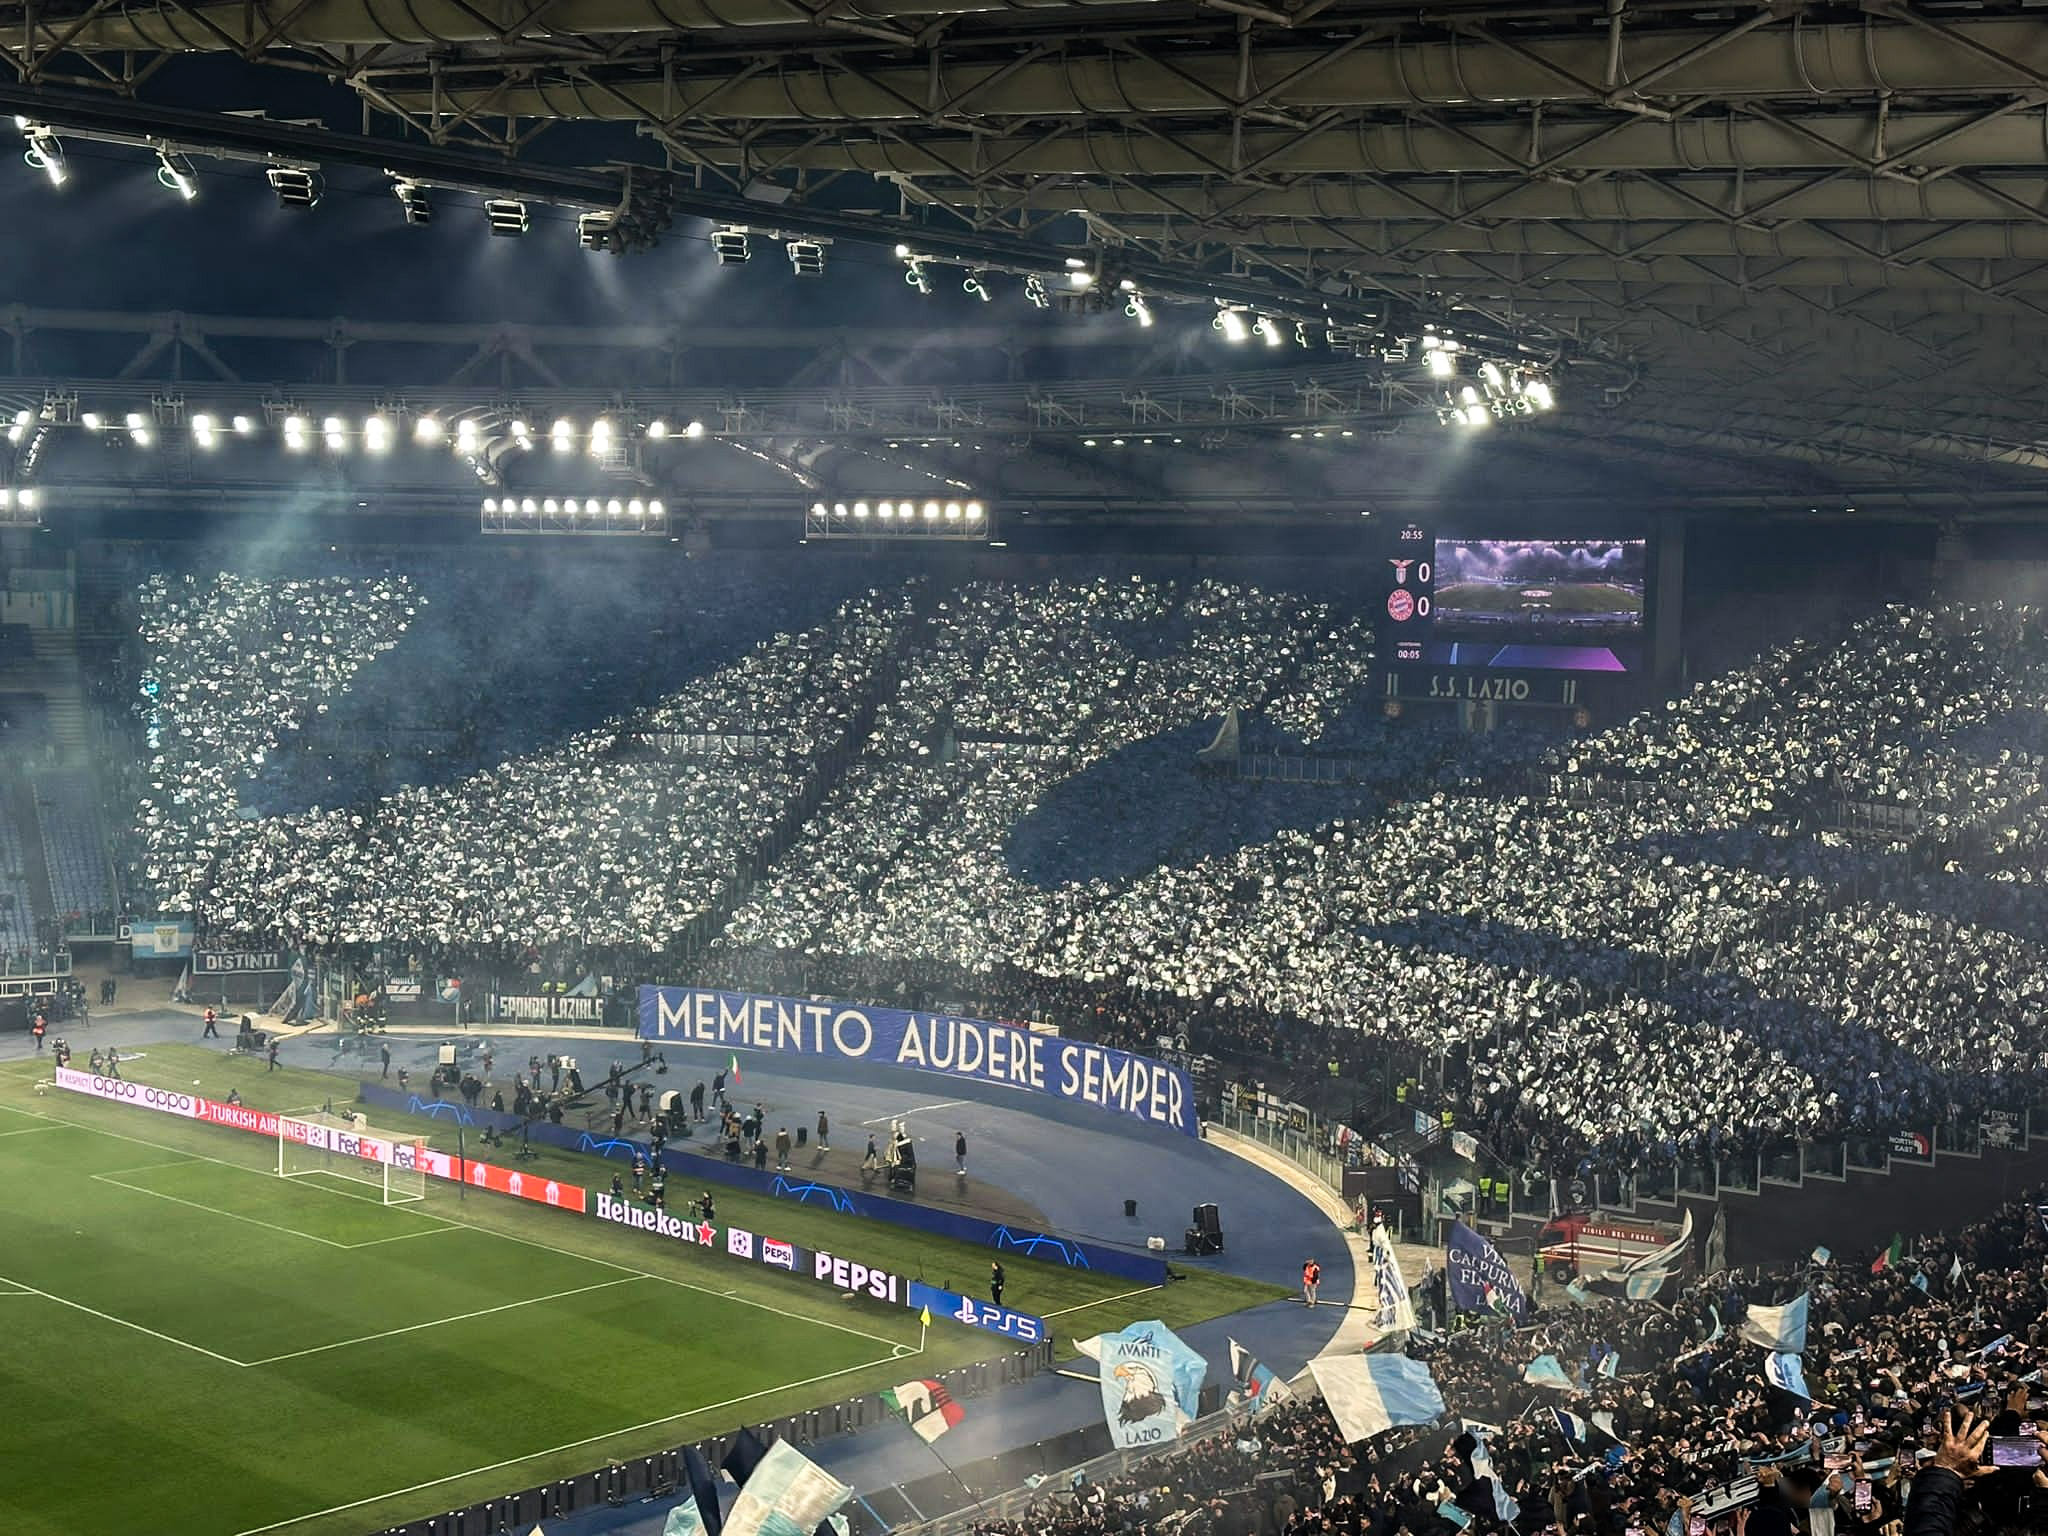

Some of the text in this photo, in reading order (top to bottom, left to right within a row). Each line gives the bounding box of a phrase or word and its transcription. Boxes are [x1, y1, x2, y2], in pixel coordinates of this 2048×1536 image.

[1418, 562, 1430, 583] 0
[1417, 596, 1430, 616] 0
[1397, 649, 1420, 659] 00:05
[1430, 674, 1529, 700] S.S. LAZIO
[206, 953, 278, 970] DISTINTI
[499, 995, 604, 1021] SPONDA LAZIALE
[657, 991, 873, 1057] MEMENTO
[896, 1015, 1045, 1089] AUDERE
[1060, 1045, 1184, 1129] SEMPER
[93, 1076, 190, 1110] oppo oppo
[210, 1104, 257, 1129] TURKISH
[338, 1132, 379, 1160] FedEx
[392, 1143, 435, 1173] FedEx
[596, 1192, 696, 1242] Heineken
[764, 1246, 792, 1263] PEPSI
[814, 1251, 897, 1303] PEPSI
[982, 1306, 1038, 1341] PS5
[1118, 1342, 1161, 1360] AVANTI
[1125, 1427, 1162, 1445] LAZIO
